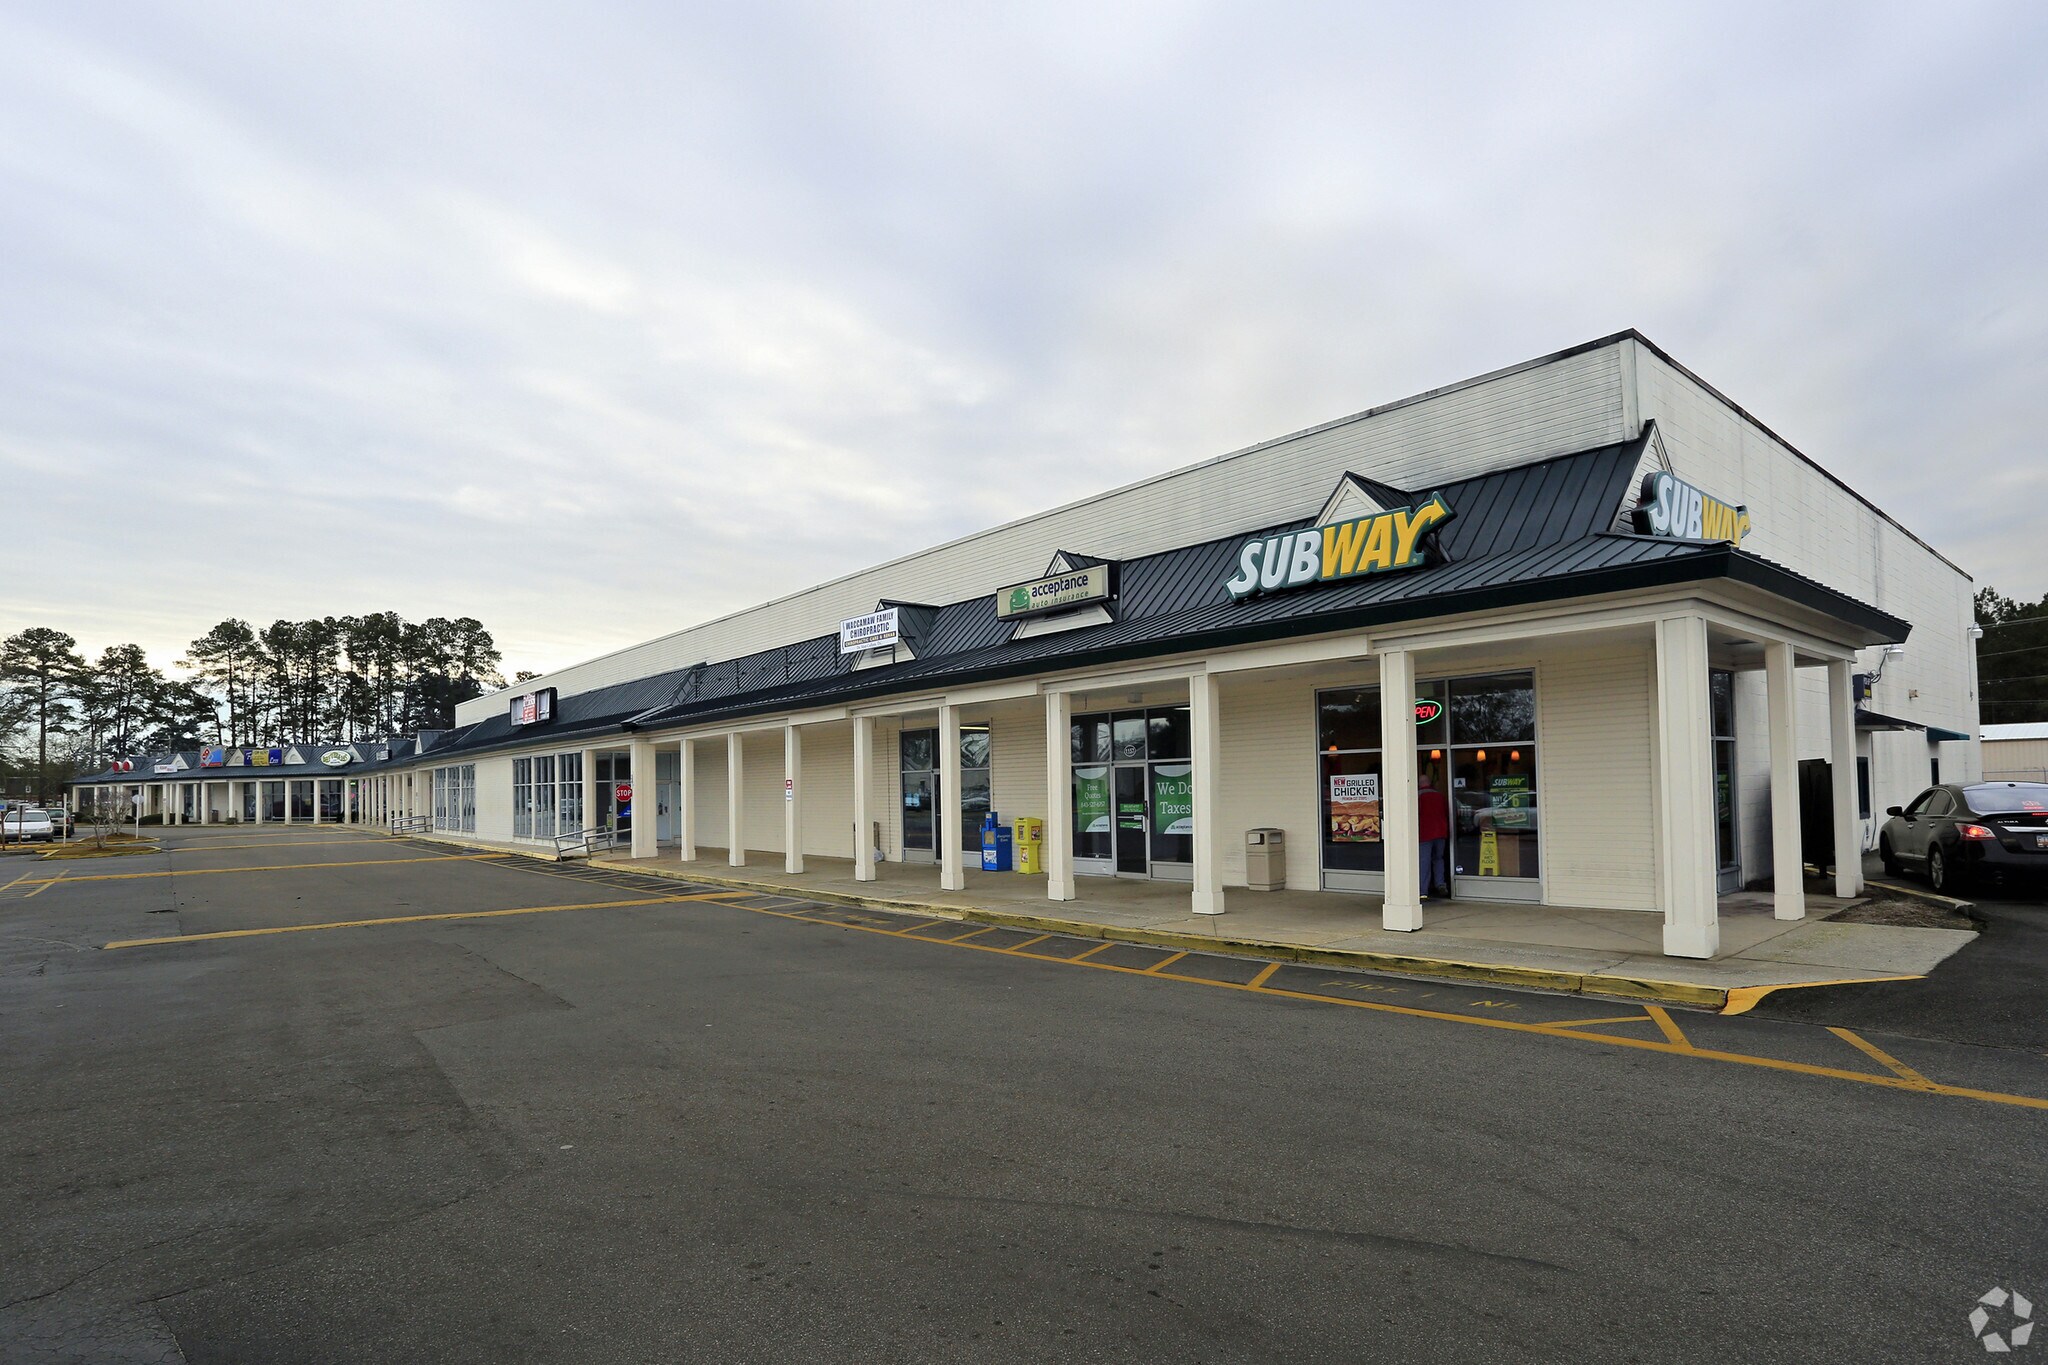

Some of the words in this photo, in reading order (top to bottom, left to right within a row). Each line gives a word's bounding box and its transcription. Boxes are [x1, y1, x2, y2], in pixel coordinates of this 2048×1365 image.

[1649, 475, 1750, 547] SUBWAY
[1226, 499, 1447, 599] SUBWAY
[1031, 574, 1089, 598] acceptance
[1031, 599, 1049, 609] auto
[1051, 590, 1089, 604] insurance
[845, 616, 876, 630] WACCAMAW
[876, 611, 894, 623] FAMILY
[850, 622, 890, 639] CHIROPRACTIC
[1415, 705, 1437, 719] PEN
[1087, 783, 1099, 791] Free
[1156, 781, 1175, 796] We
[1177, 781, 1193, 795] Do
[1334, 778, 1346, 786] NEW
[1346, 779, 1375, 787] GRILLED
[1492, 777, 1525, 787] SUBWAY
[616, 789, 632, 797] STOP
[1084, 791, 1102, 801] Quotes
[1333, 786, 1375, 797] CHICKEN
[1159, 801, 1192, 815] Taxes
